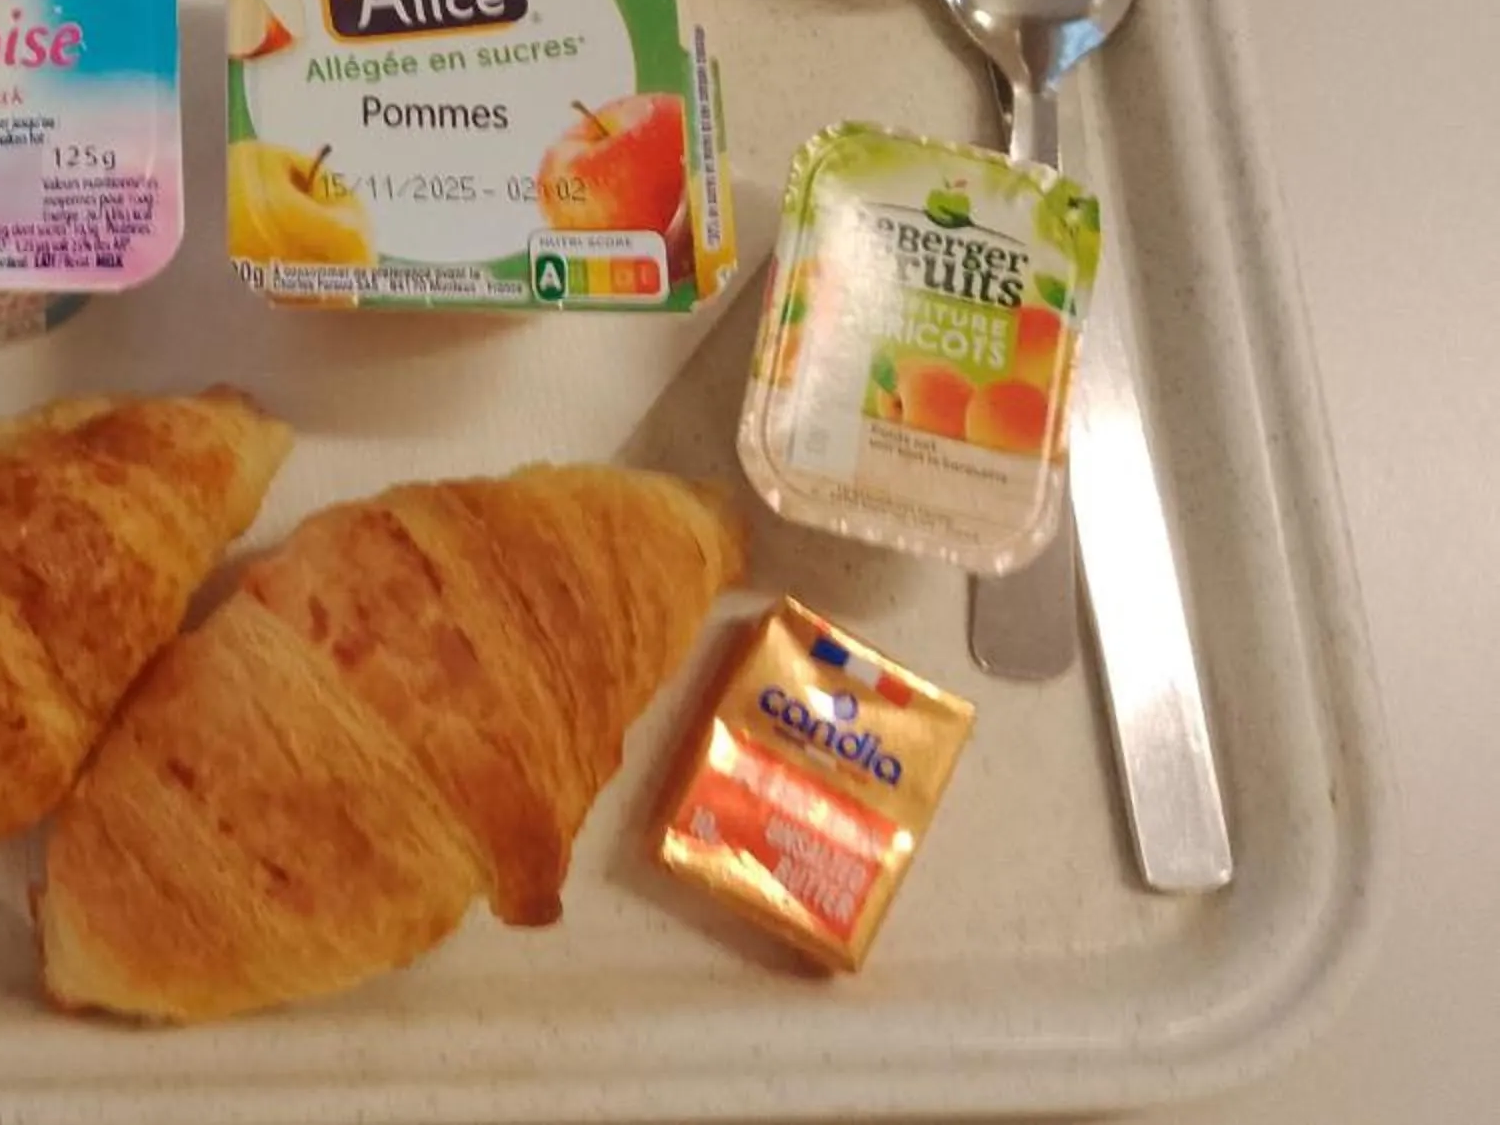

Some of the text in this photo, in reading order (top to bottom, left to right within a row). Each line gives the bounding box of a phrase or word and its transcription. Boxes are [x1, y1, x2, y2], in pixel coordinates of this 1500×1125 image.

[305, 50, 419, 84] Allégée
[429, 49, 467, 72] en
[361, 94, 509, 130] Pommes
[54, 146, 115, 171] 125g
[898, 222, 1029, 274] Berger
[539, 260, 563, 292] A
[887, 252, 1024, 308] ruits
[890, 293, 1008, 338] ITURE
[872, 311, 1006, 370] RICOTS
[758, 688, 903, 787] candia
